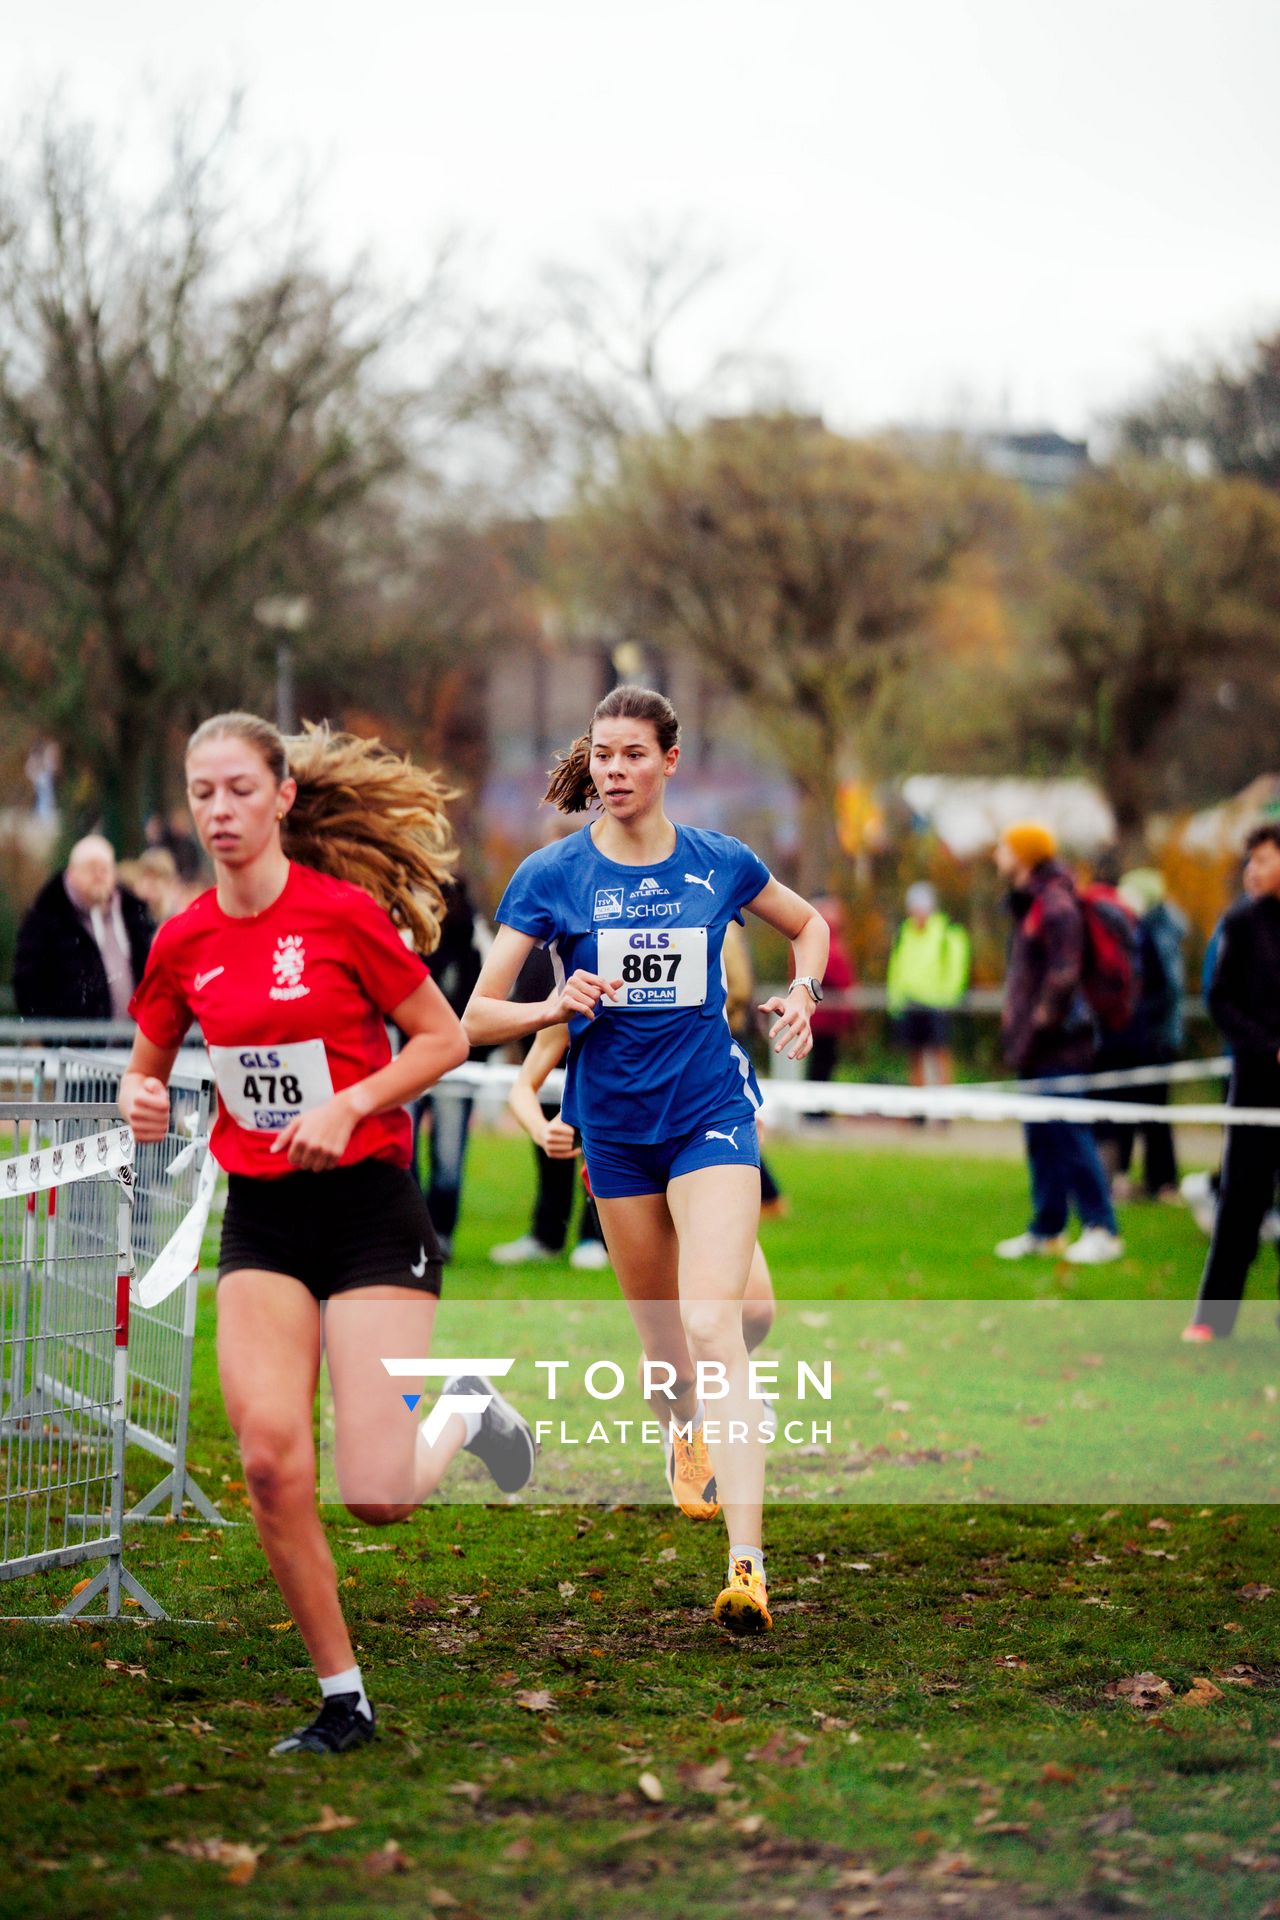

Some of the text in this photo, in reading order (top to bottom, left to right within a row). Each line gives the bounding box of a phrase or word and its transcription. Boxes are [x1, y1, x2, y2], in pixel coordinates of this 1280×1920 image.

[629, 888, 670, 898] ATLETICA
[626, 902, 682, 918] SCHOTT
[622, 953, 682, 983] 867
[647, 990, 675, 999] PLAN
[243, 1074, 303, 1105] 478
